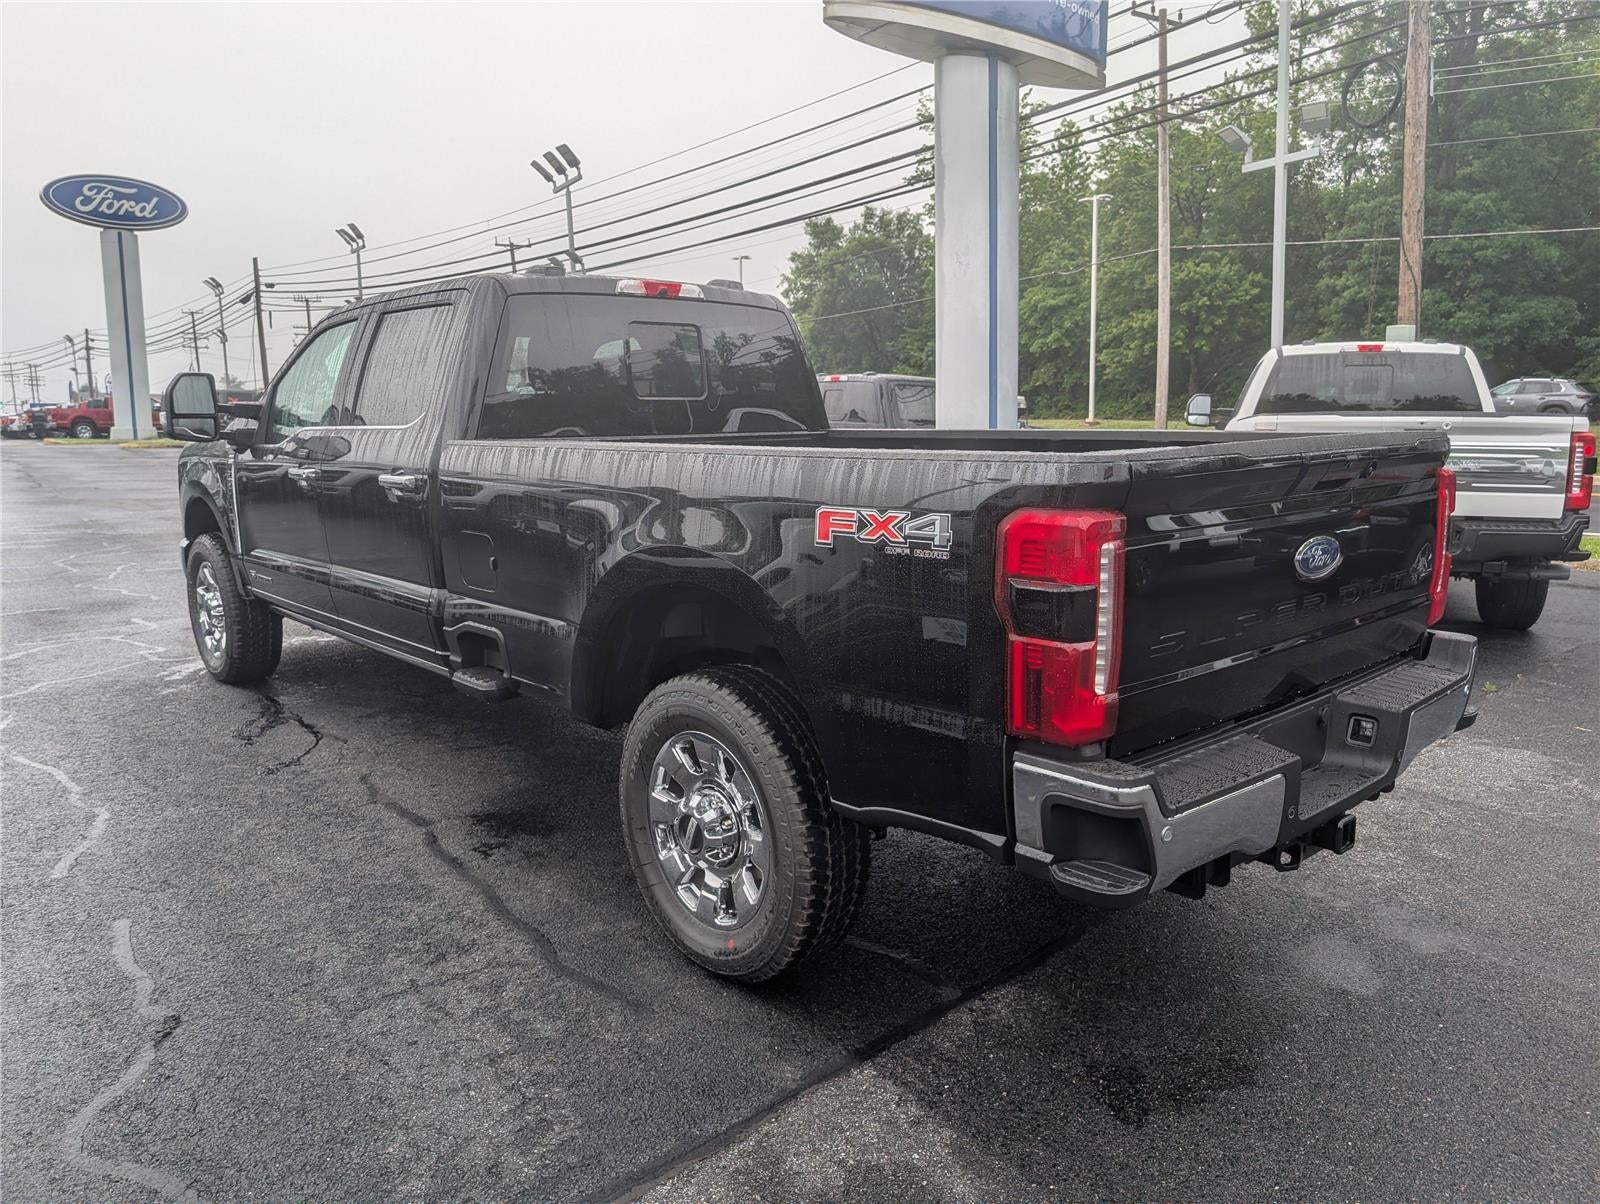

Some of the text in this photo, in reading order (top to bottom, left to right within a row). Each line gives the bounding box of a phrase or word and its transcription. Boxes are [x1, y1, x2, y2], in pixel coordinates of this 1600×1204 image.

[1048, 0, 1100, 24] re-owned
[75, 182, 158, 218] Ford
[814, 505, 952, 551] FX4
[1308, 544, 1331, 569] Ford
[1338, 567, 1426, 604] DUT
